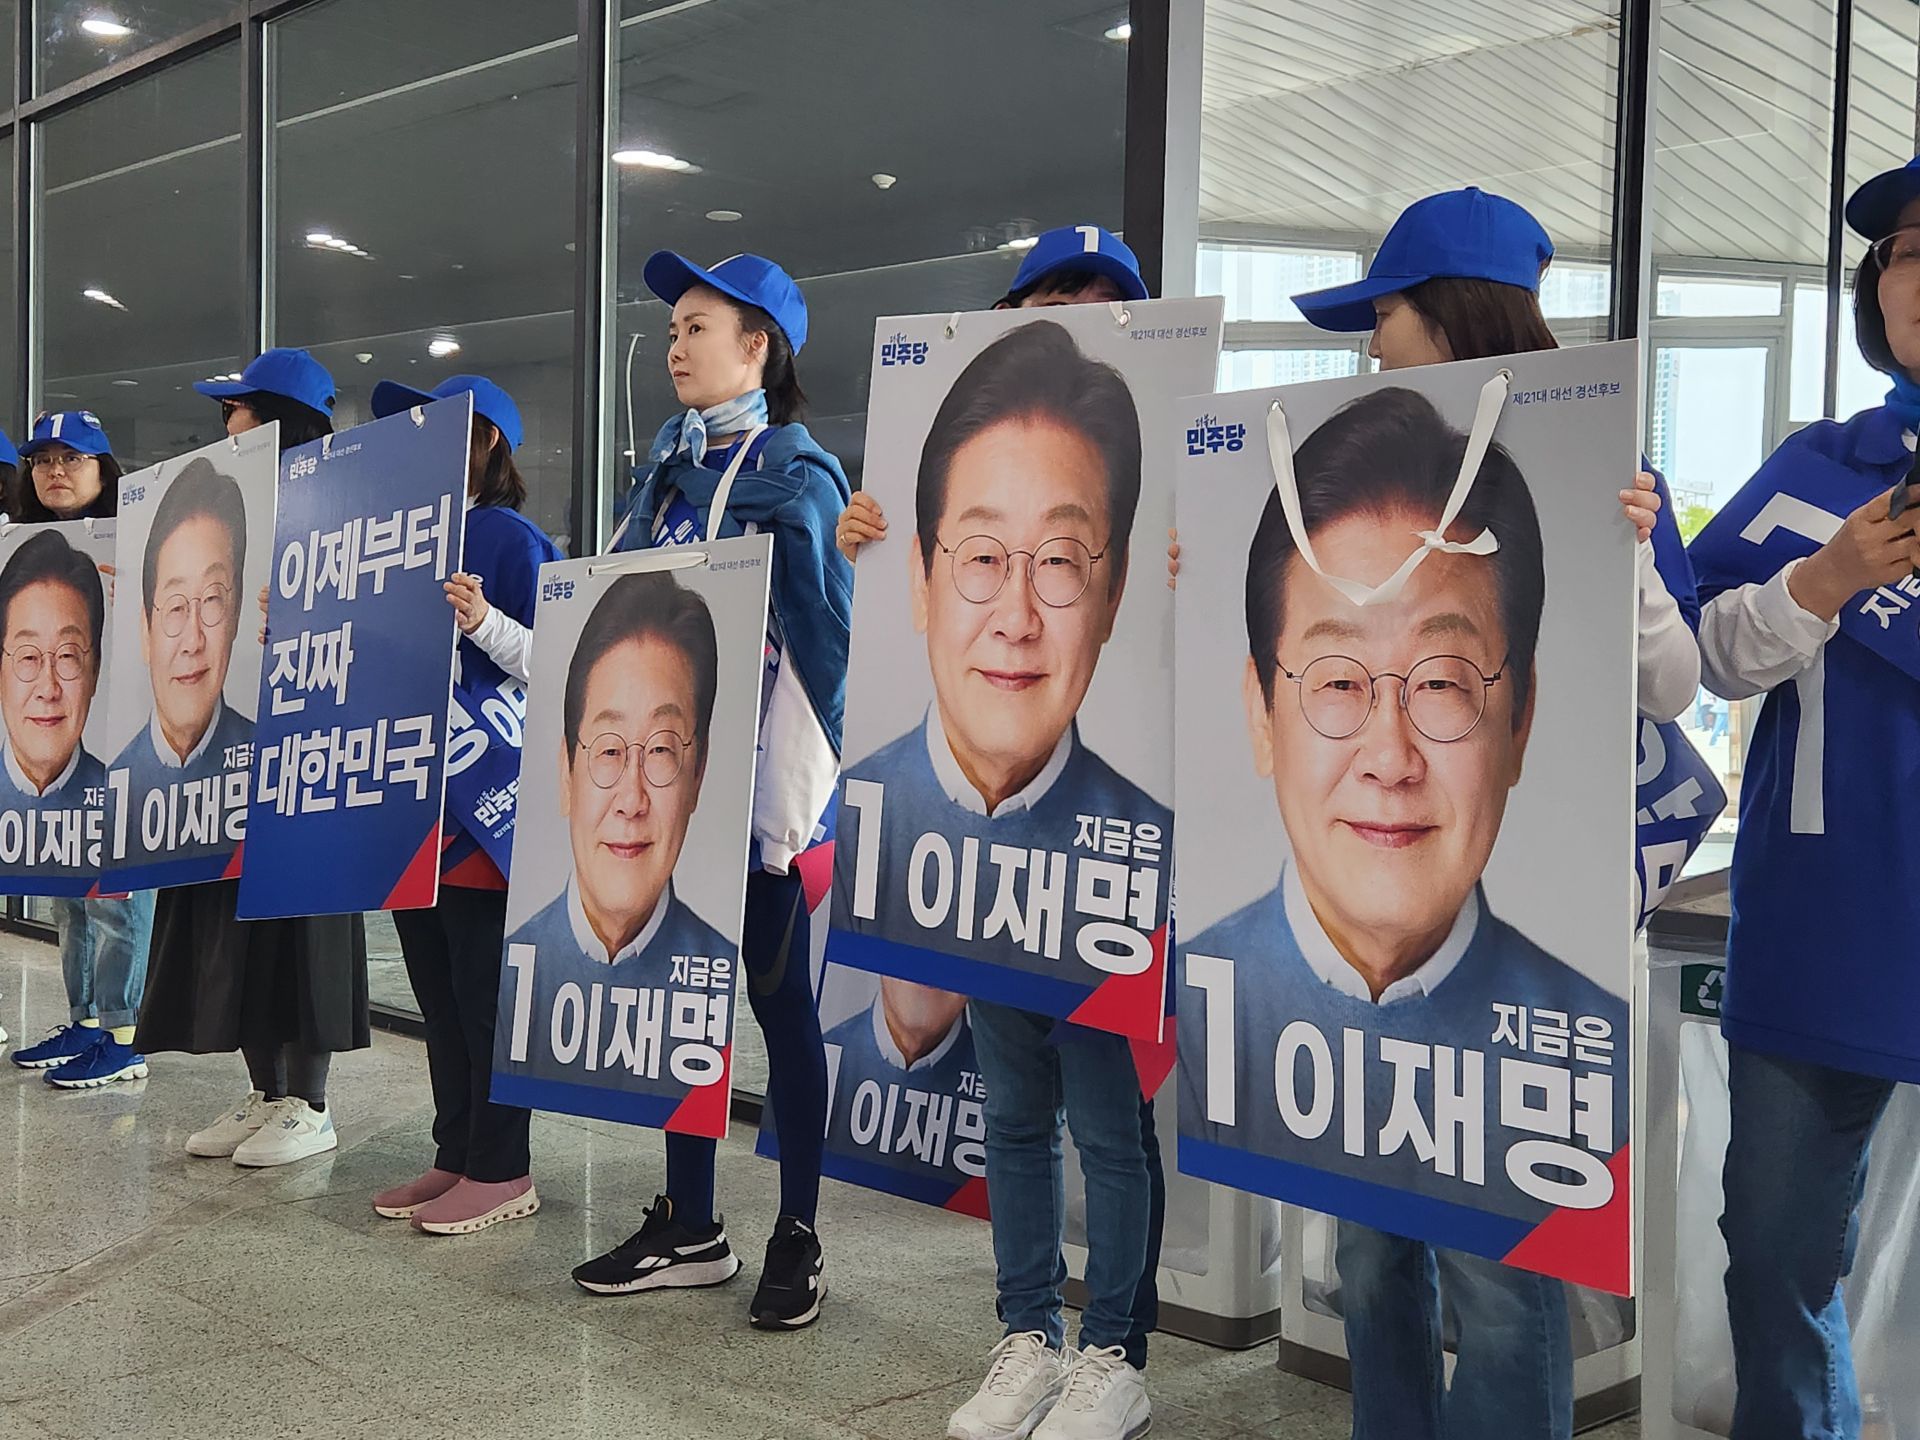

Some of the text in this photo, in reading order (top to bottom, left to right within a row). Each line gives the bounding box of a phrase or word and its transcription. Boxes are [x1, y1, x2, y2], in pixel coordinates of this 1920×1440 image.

[1074, 225, 1099, 253] 1
[881, 342, 929, 366] 민주당
[1130, 326, 1208, 340] 제21대 대선 경선후보
[1512, 381, 1621, 405] 제21대 대선 경선후보
[50, 413, 65, 438] 1
[1186, 423, 1246, 456] 민주당
[288, 457, 317, 480] 민주당
[278, 493, 451, 612] 이제부터
[542, 579, 575, 602] 민주당
[268, 621, 354, 716] 진짜
[257, 714, 436, 817] 대한민국
[108, 767, 131, 860] 1
[1072, 813, 1163, 862] 지금은
[845, 778, 1160, 976] 1 이재명
[668, 955, 732, 990] 지금은
[507, 943, 730, 1087] 1 이재명
[1491, 1001, 1616, 1067] 지금은
[1185, 953, 1616, 1210] 1 이재명
